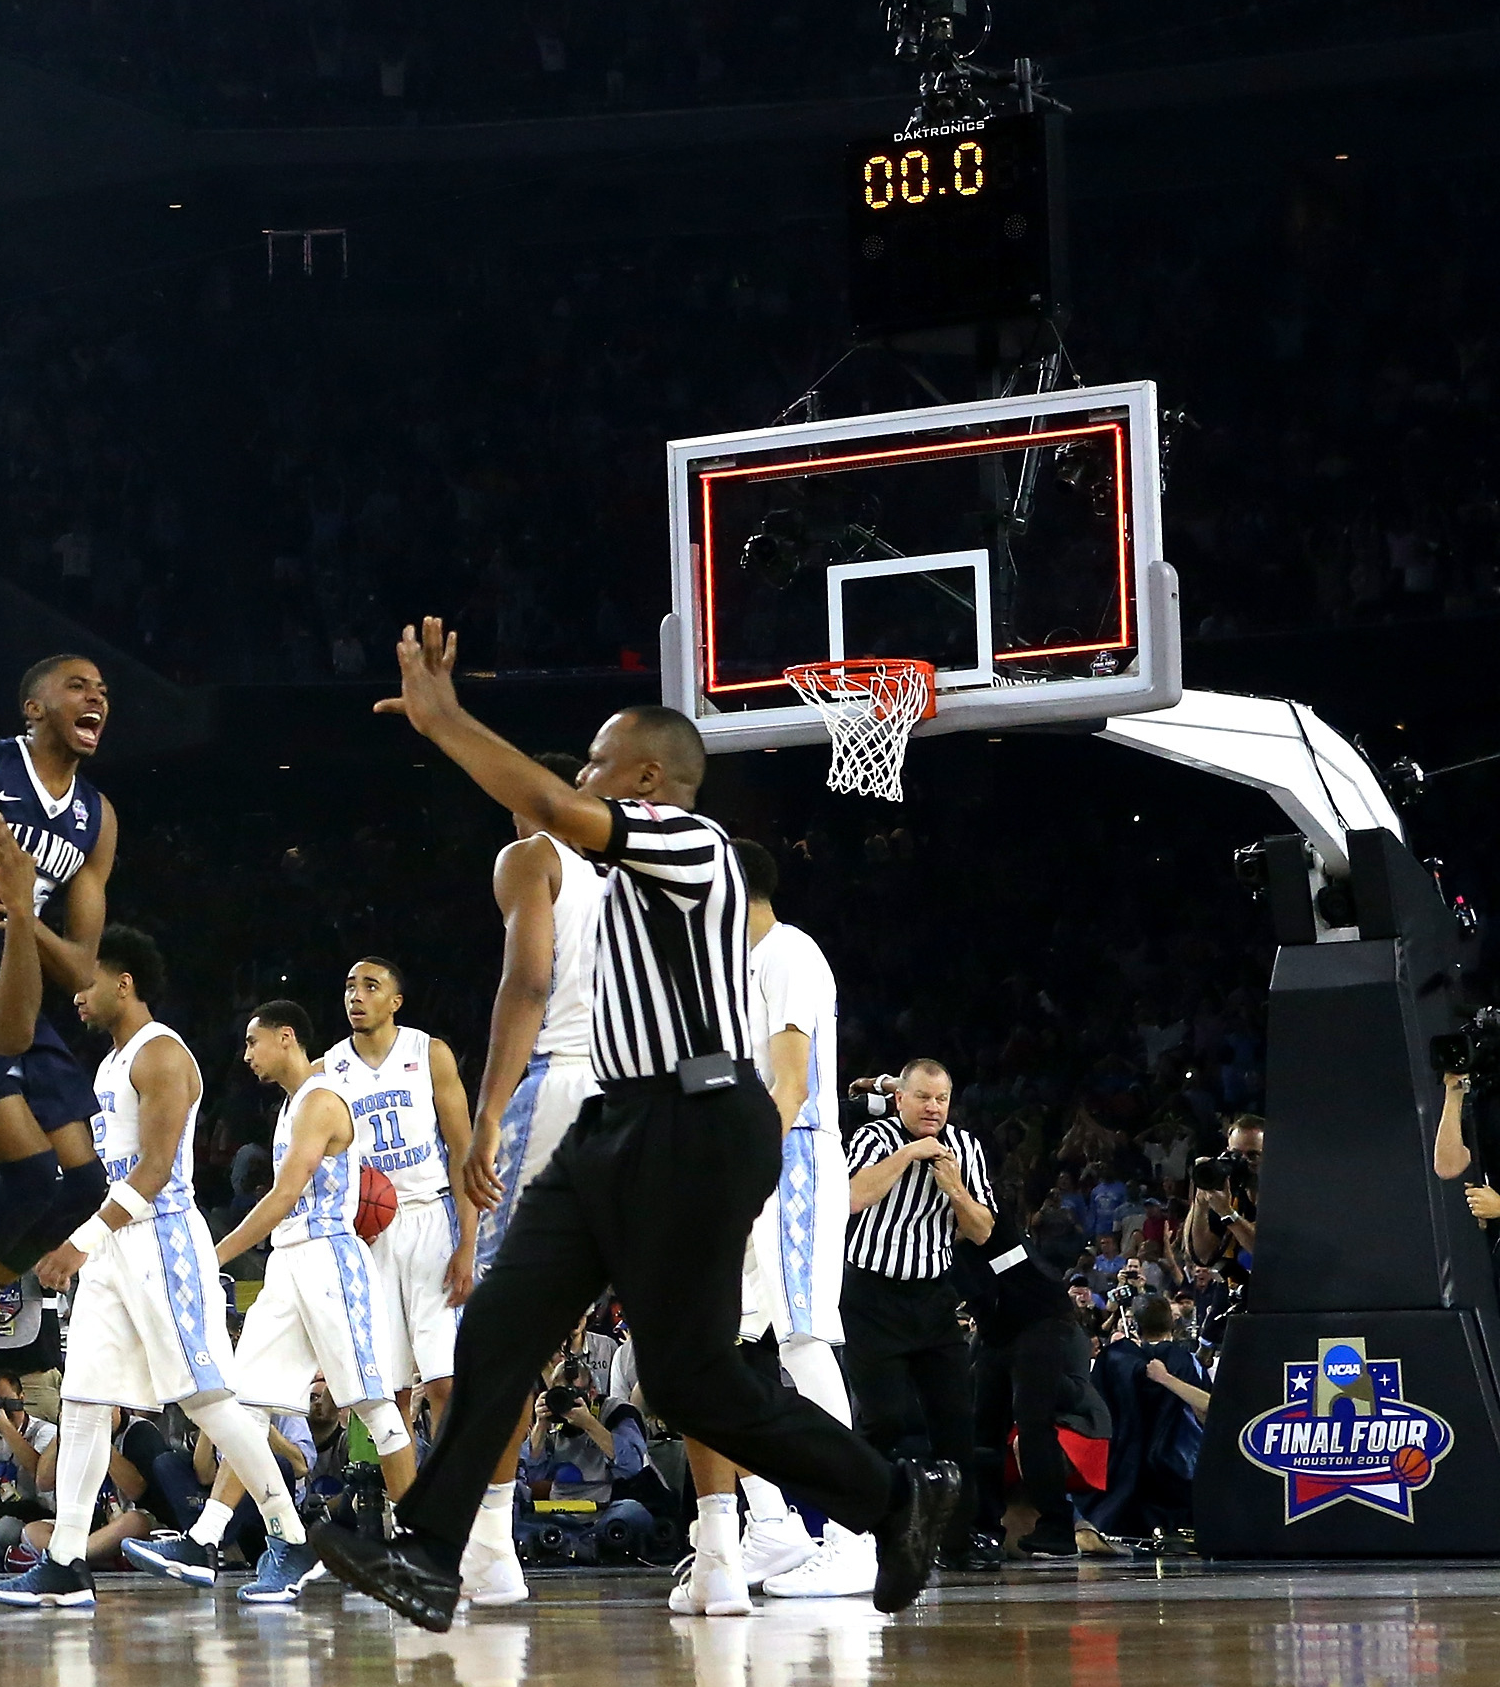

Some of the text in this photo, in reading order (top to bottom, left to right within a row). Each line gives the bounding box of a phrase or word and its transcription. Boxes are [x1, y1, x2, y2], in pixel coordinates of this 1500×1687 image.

[893, 120, 985, 142] DAKTRONICS
[864, 142, 983, 209] 00.0
[351, 1090, 414, 1119] NORTH
[368, 1110, 407, 1152] 11
[361, 1141, 432, 1172] AROLIN
[592, 1360, 608, 1370] 210
[1326, 1363, 1362, 1377] NCAA
[1263, 1419, 1429, 1455] FINAL FOUR
[1292, 1455, 1390, 1466] HOUSTON 2016
